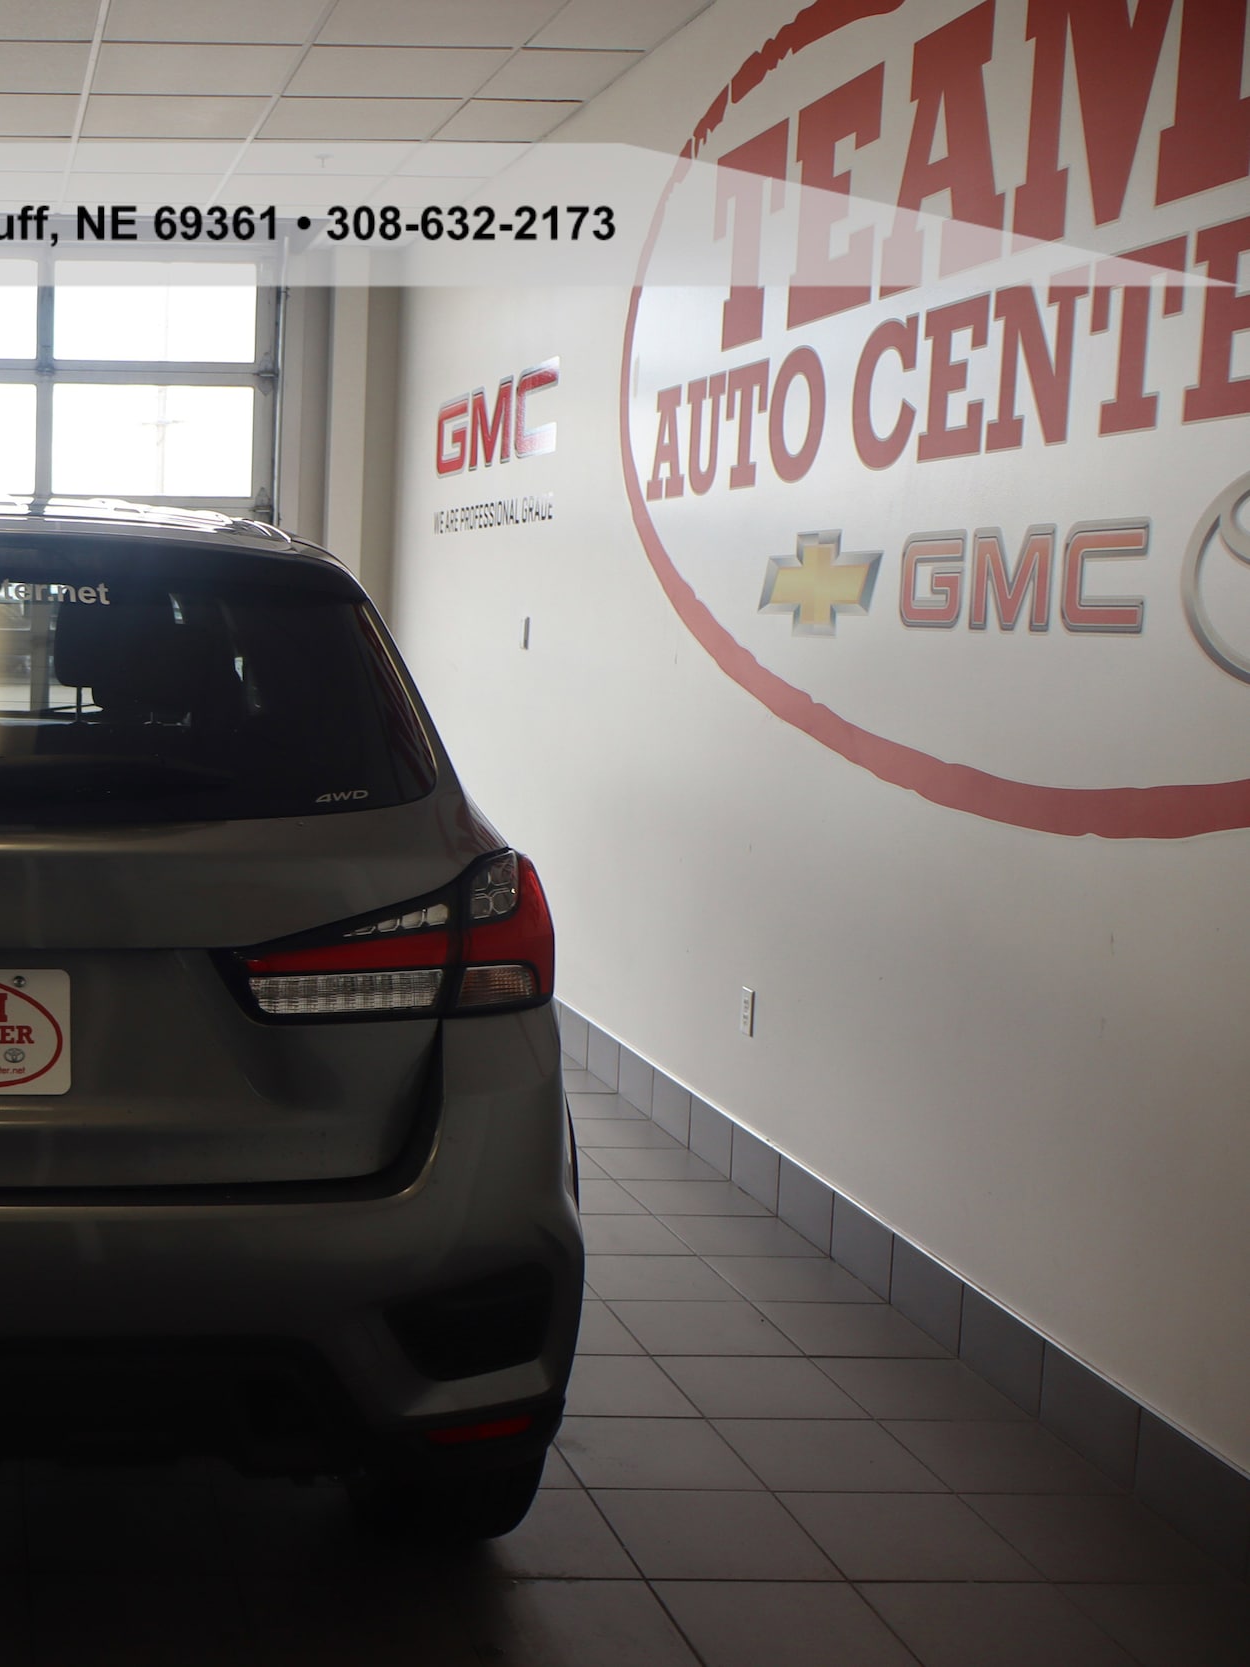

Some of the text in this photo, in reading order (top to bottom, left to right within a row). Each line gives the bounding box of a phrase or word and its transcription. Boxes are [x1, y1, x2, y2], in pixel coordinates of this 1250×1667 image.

[713, 0, 1250, 352] TEAM
[436, 355, 560, 480] GMC
[646, 344, 826, 502] AUTO
[433, 493, 554, 535] WE ARE PROFESSIONAL GRADE
[899, 516, 1151, 634] GMC
[316, 789, 369, 803] 4WD
